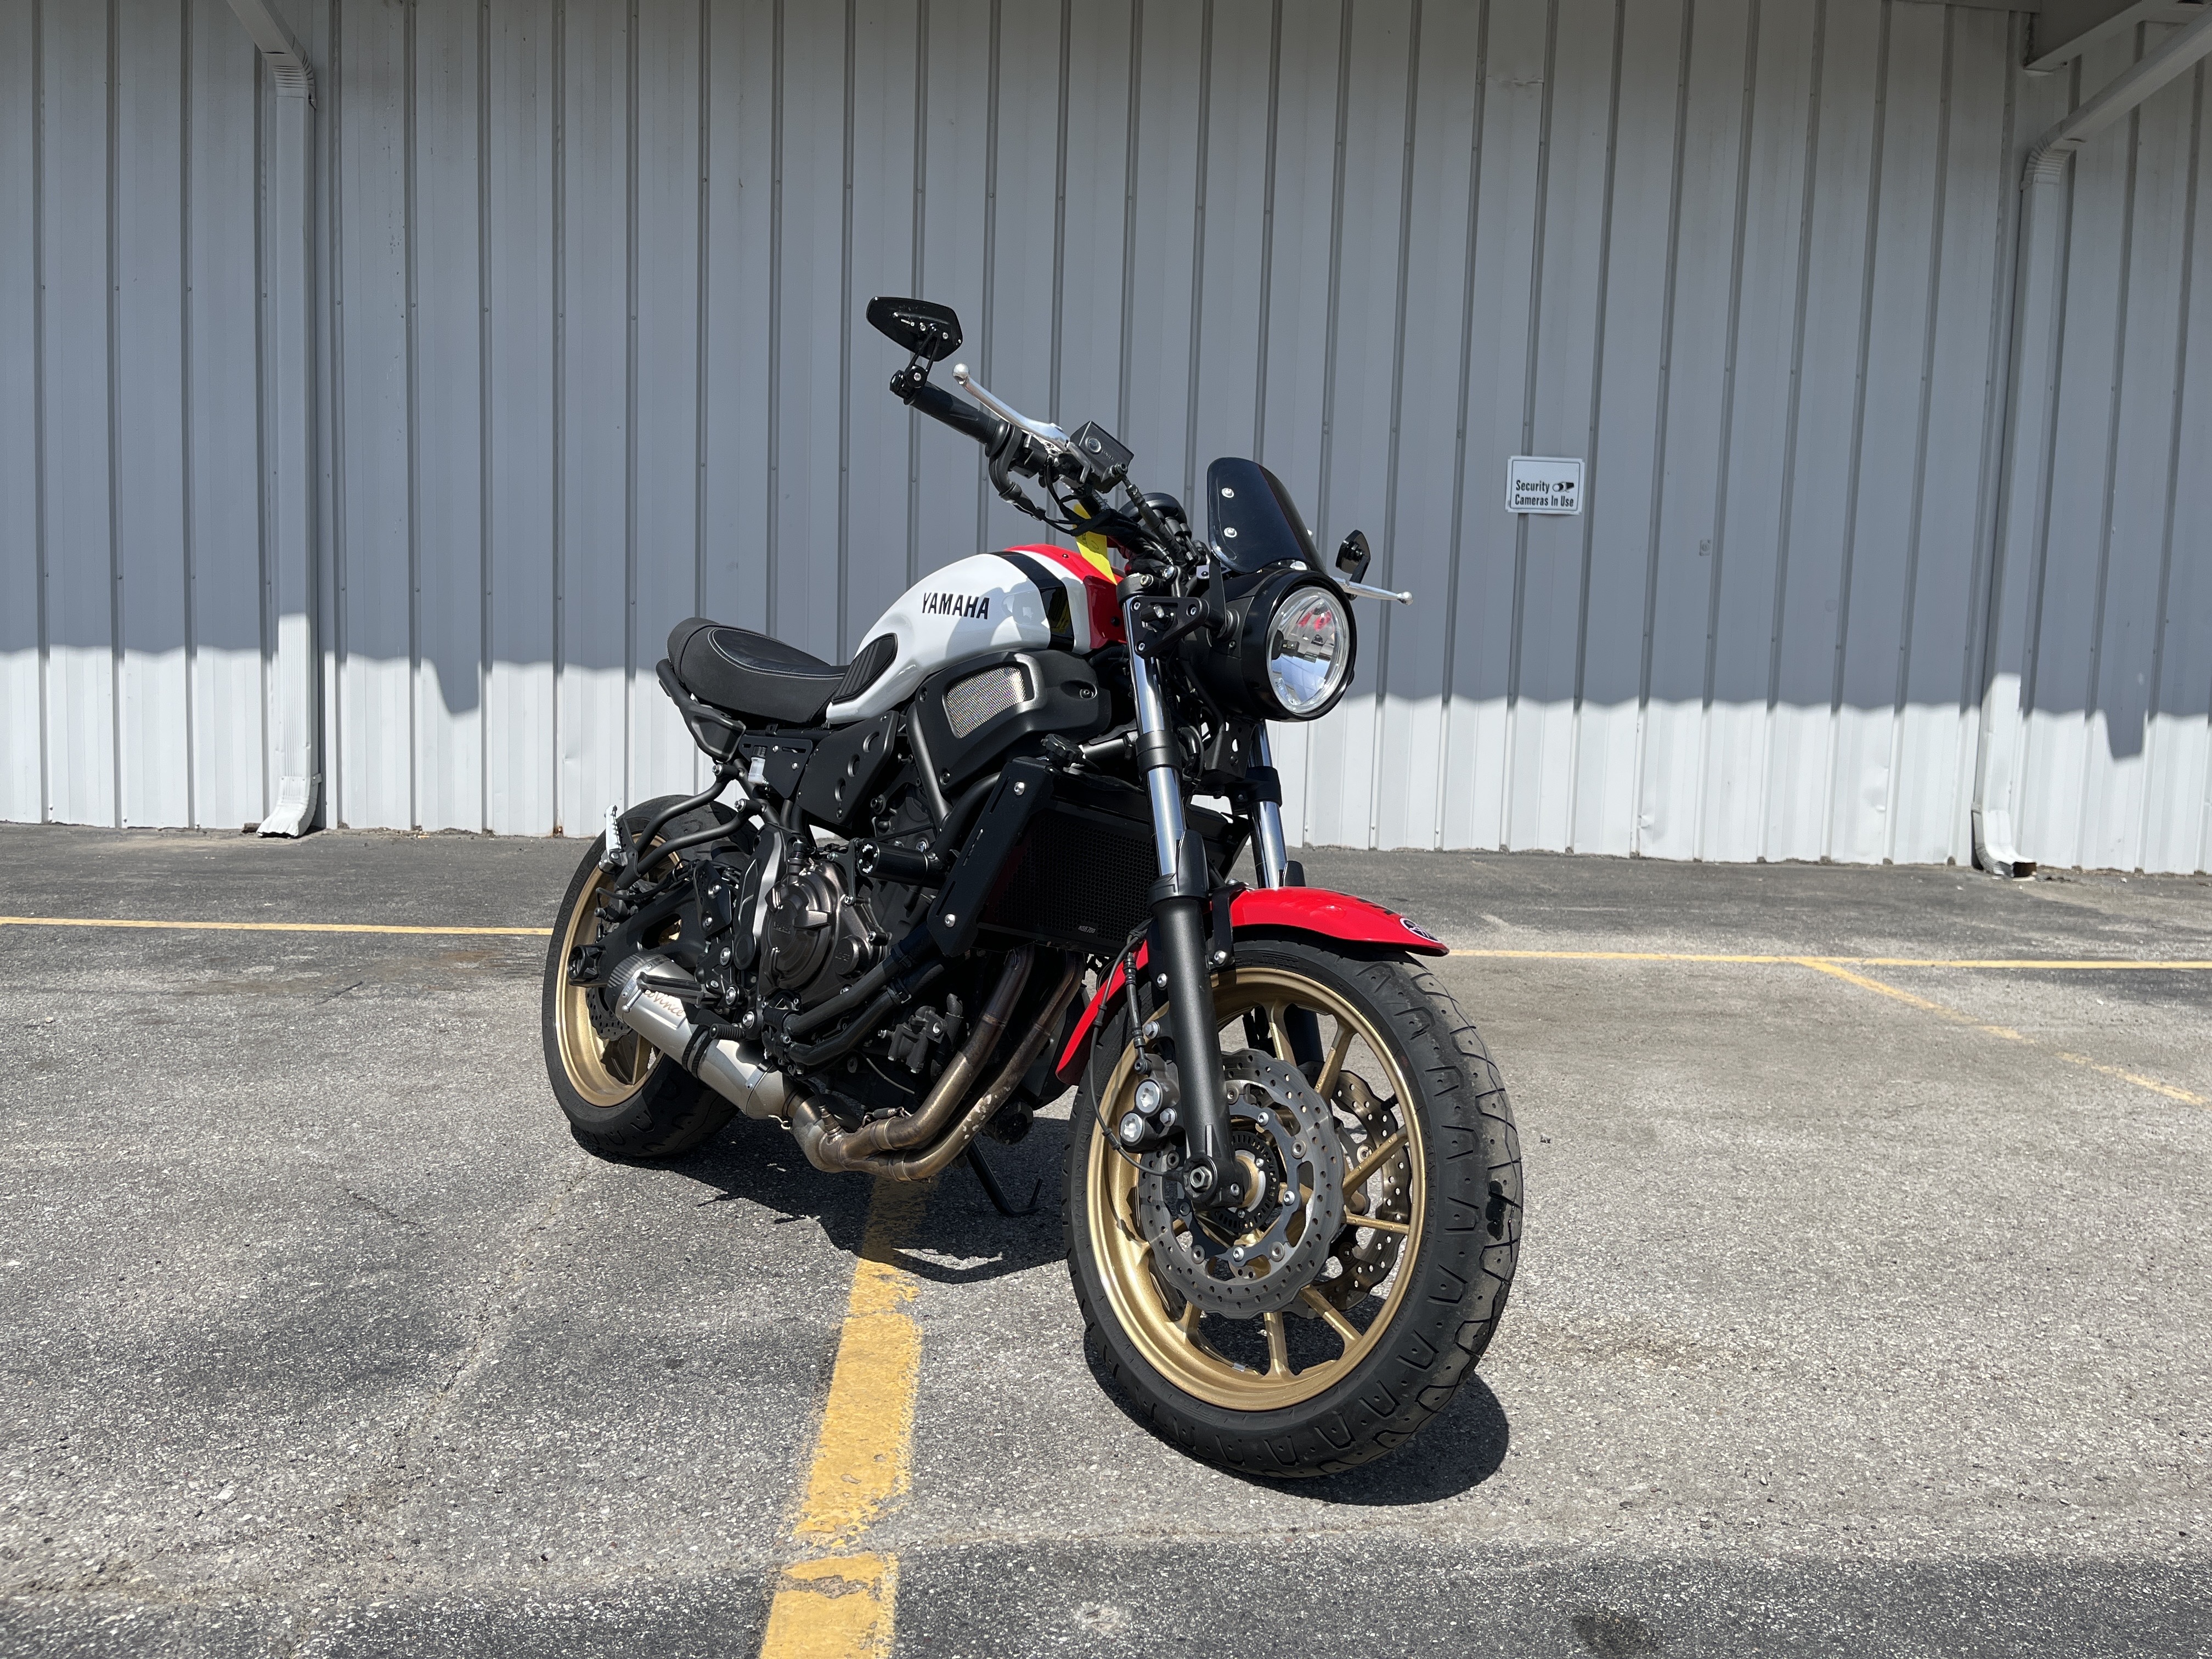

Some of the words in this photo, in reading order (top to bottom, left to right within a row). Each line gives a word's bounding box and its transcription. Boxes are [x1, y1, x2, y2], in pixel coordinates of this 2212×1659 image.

[1516, 479, 1550, 494] Security
[1515, 494, 1549, 506] Cameras
[1551, 495, 1558, 506] In
[1560, 496, 1574, 507] Use
[922, 592, 990, 620] YAMAHA
[1077, 925, 1096, 934] XSR700
[644, 989, 685, 1017] eoVince
